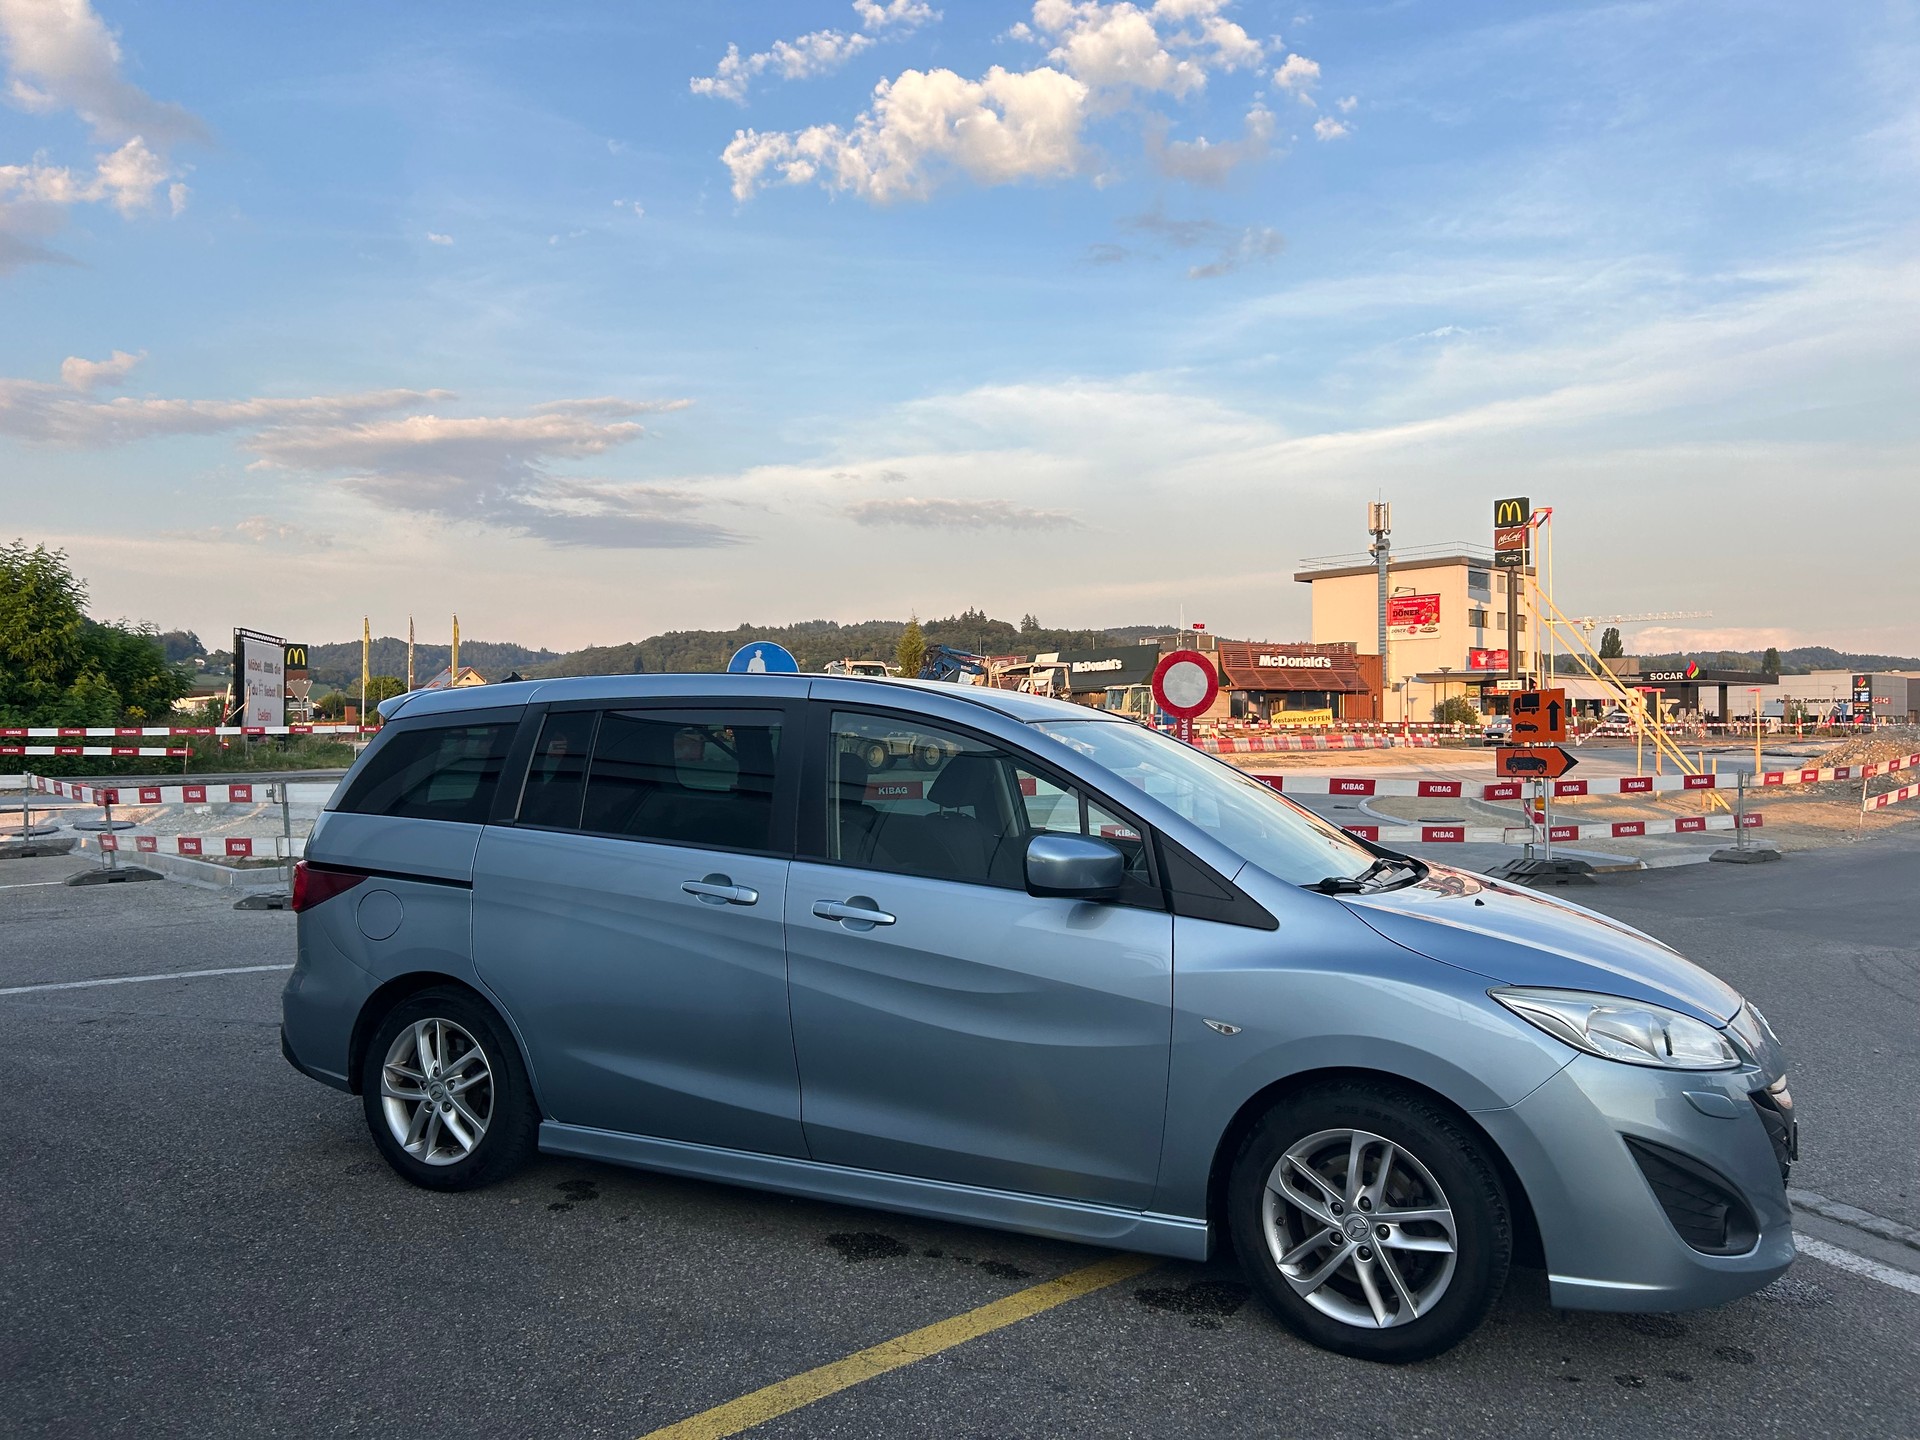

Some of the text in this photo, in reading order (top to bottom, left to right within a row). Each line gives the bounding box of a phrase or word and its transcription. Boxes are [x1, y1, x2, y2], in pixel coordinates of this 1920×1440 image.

[1072, 659, 1122, 672] McDonald's
[1259, 655, 1331, 668] McDonald's
[1649, 672, 1684, 681] SOCAR
[1308, 714, 1331, 723] OFFEN
[1628, 781, 1645, 789] KIBAG
[1691, 777, 1708, 785] KIBAG
[878, 786, 908, 795] KIBAG
[1341, 783, 1365, 791] KIBAG
[1429, 785, 1452, 793] KIBAG
[1562, 784, 1580, 792] KIBAG
[234, 789, 247, 798] KIBAG
[1494, 788, 1513, 796] KIBAG
[1115, 829, 1137, 837] KIBA
[1620, 825, 1638, 833] KIBAG
[1551, 830, 1571, 838] KIBAG
[183, 842, 197, 850] KIBAG
[231, 843, 246, 852] KIBAG
